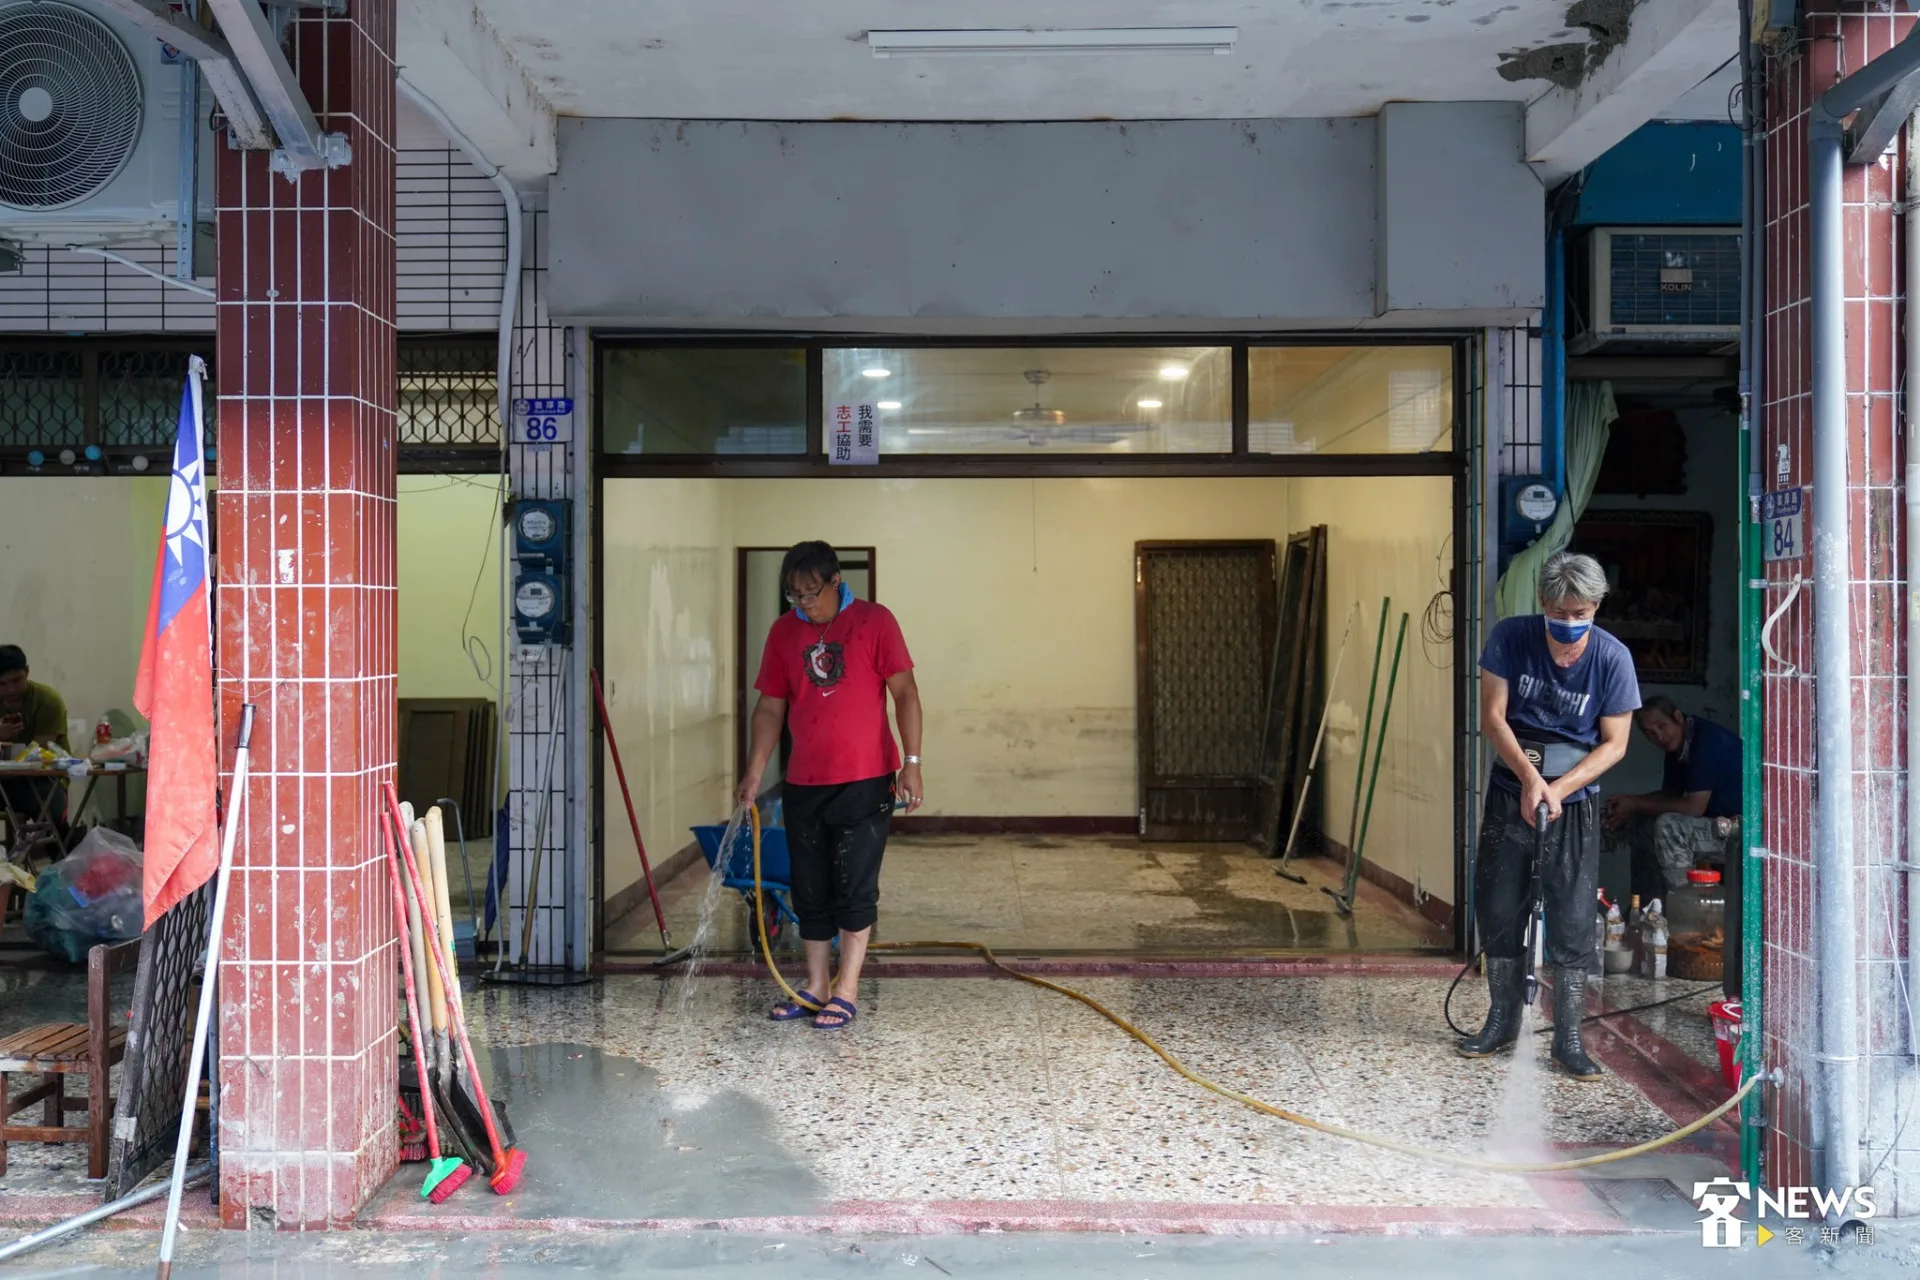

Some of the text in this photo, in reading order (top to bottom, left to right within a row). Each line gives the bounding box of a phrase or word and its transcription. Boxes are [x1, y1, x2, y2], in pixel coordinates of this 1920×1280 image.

[1661, 283, 1692, 291] KOLIN
[526, 417, 557, 441] 86
[836, 404, 852, 460] 志工協助
[858, 404, 873, 447] 我需要
[1774, 518, 1794, 556] 84
